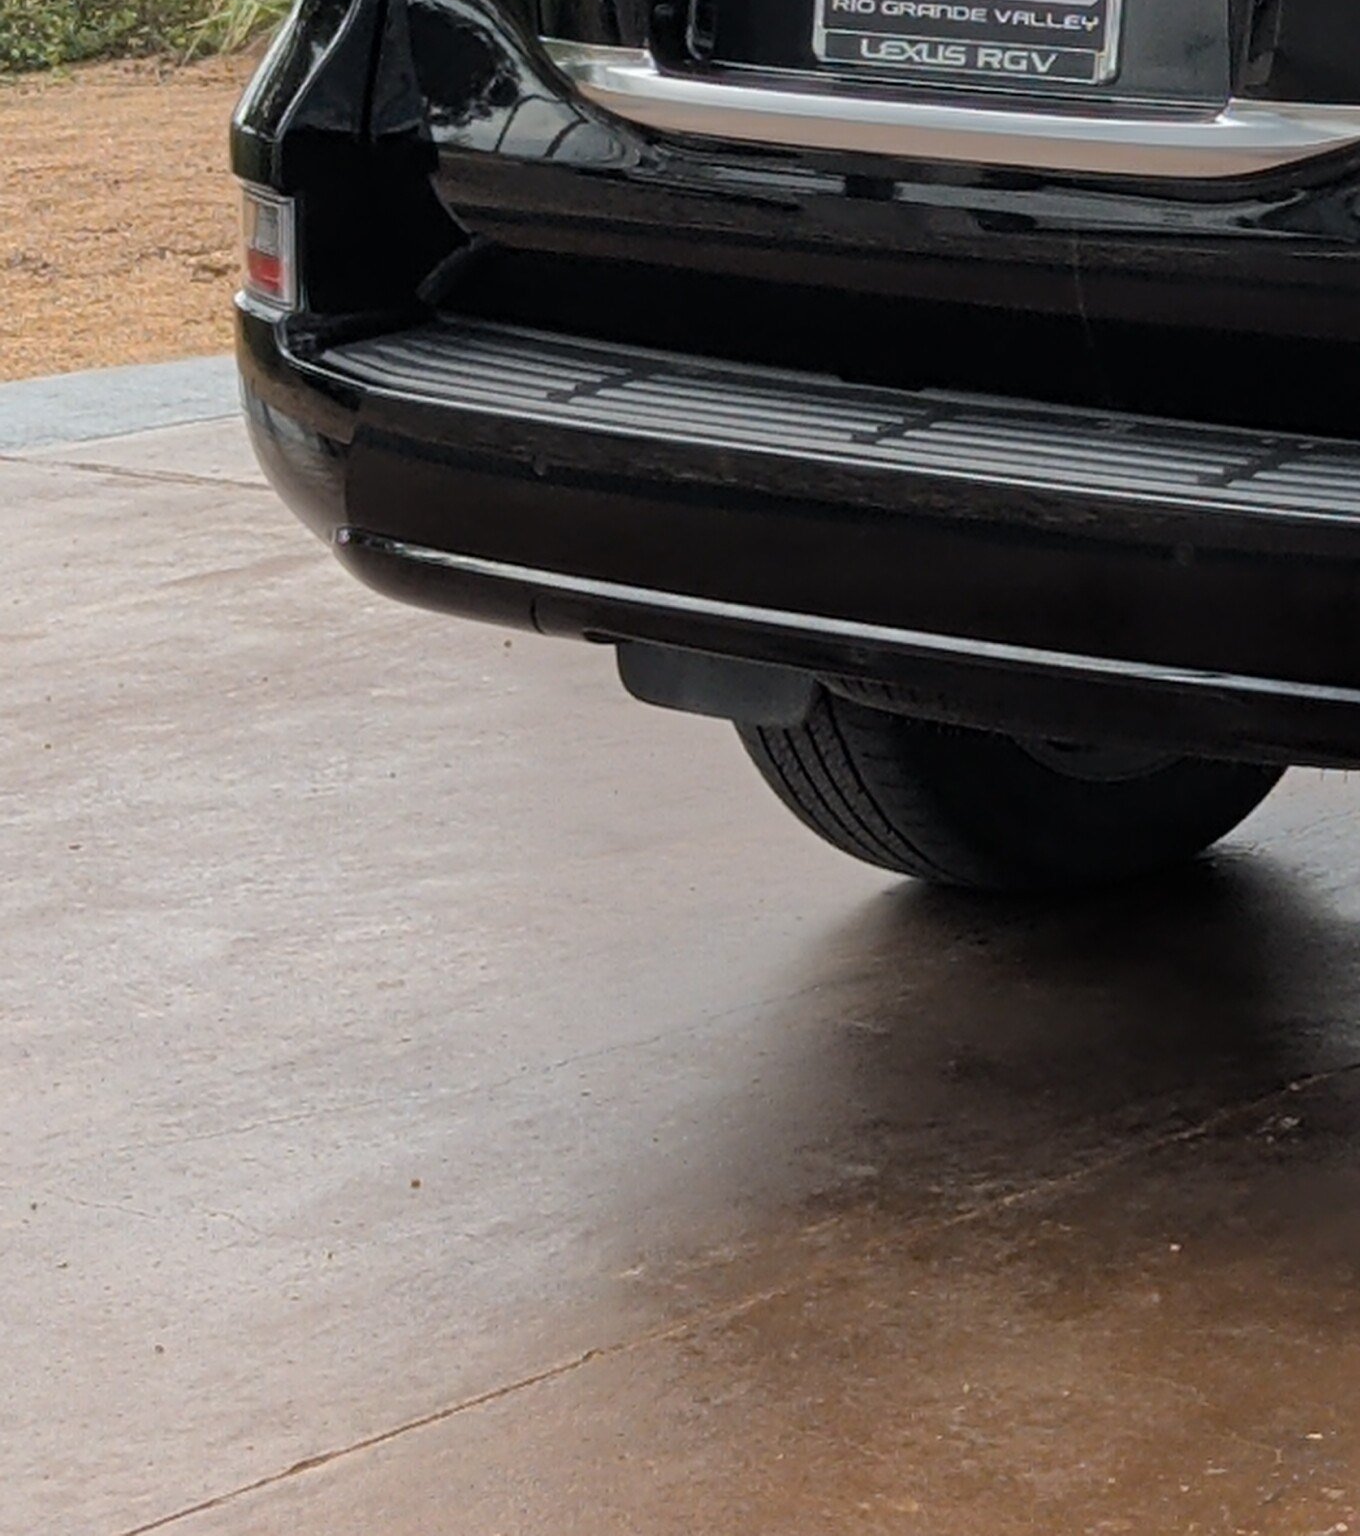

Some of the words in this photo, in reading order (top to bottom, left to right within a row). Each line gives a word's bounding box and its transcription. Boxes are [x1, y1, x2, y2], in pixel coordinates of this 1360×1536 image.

[881, 0, 988, 23] GRANDE
[993, 8, 1100, 32] VALLEY
[860, 38, 967, 66] LEXUS
[977, 51, 1059, 73] RGV
